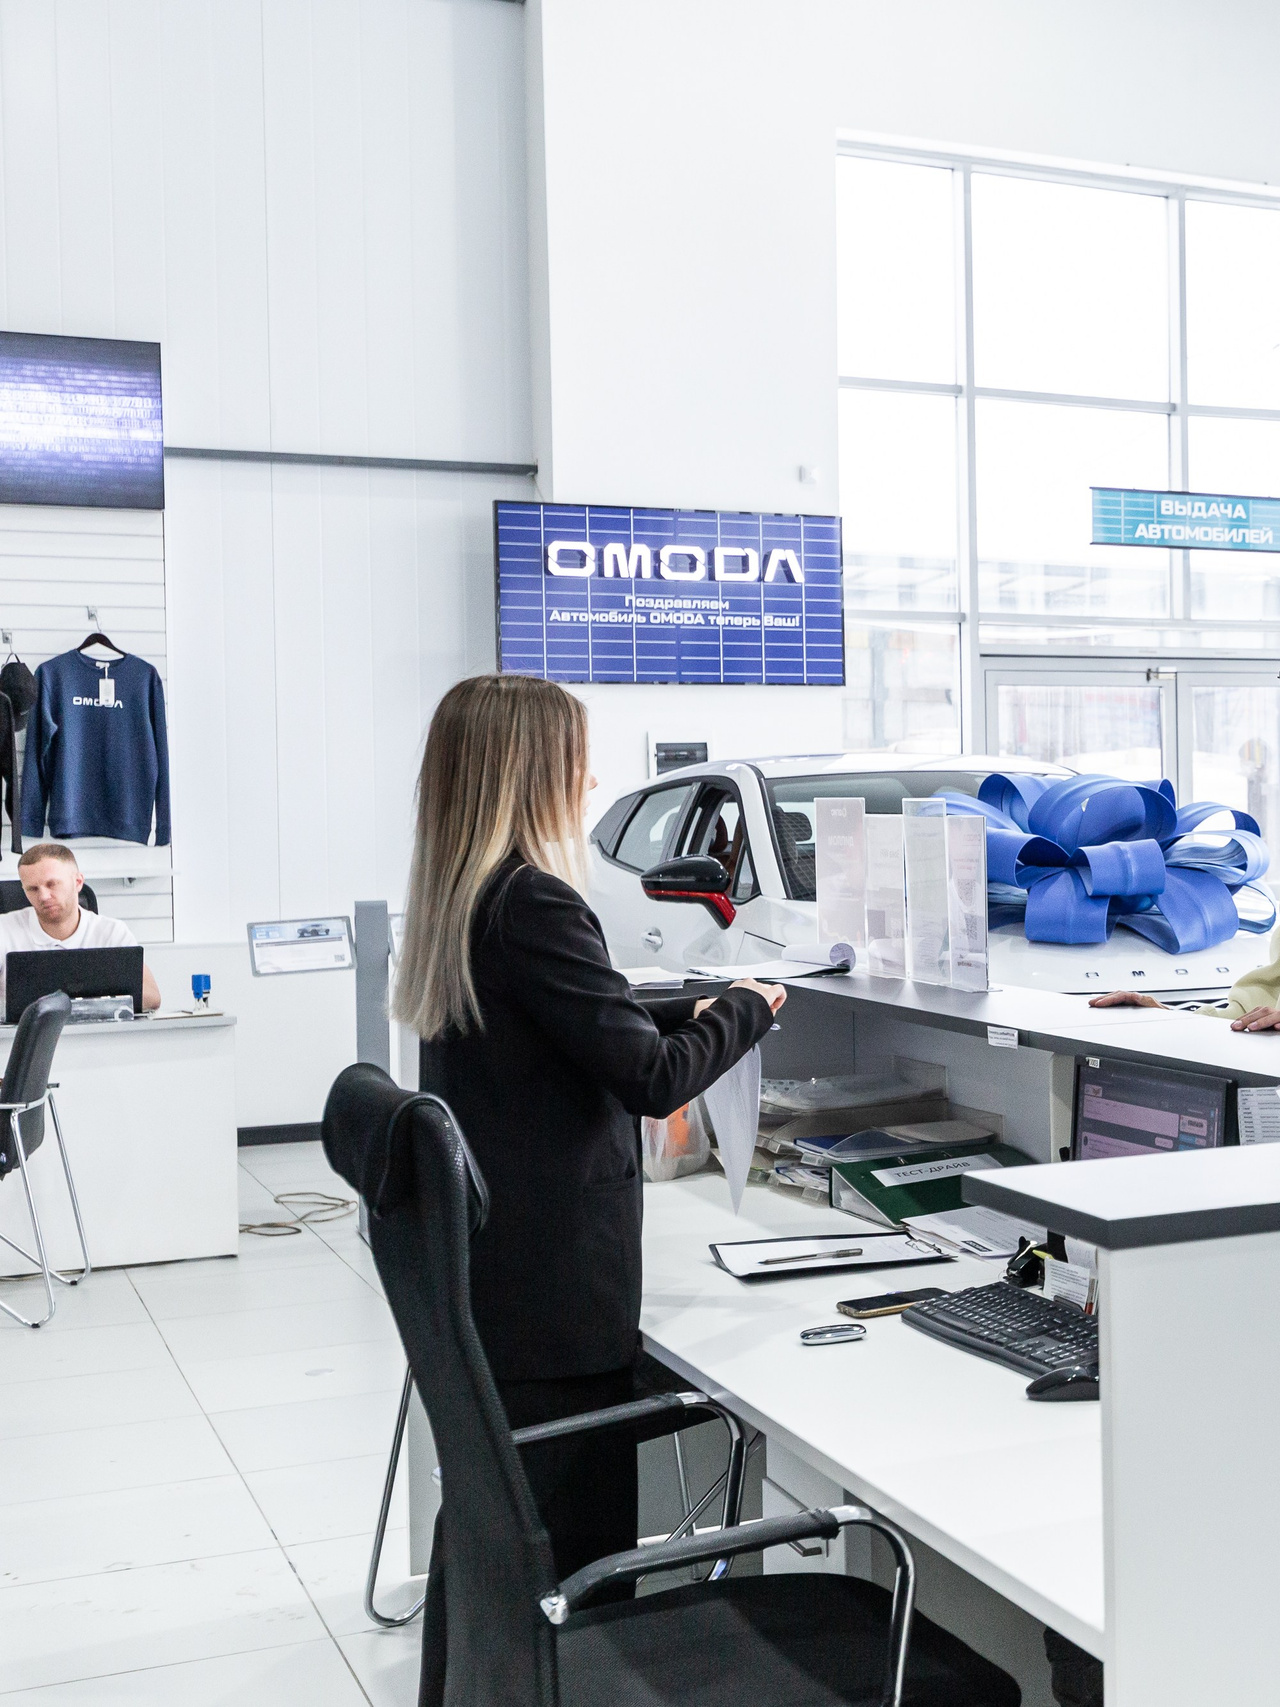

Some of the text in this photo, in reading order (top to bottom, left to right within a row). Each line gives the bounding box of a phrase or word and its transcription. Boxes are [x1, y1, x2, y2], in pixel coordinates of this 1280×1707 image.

[1160, 499, 1247, 519] ВЫДАЧА
[1134, 523, 1274, 544] АВТОМОБИЛЕЙ
[547, 540, 805, 583] OMODA
[624, 595, 729, 611] Поздравляем
[549, 609, 800, 628] Автомобиль OMODA теперь Ваш!
[72, 696, 123, 709] OMOA
[1085, 965, 1260, 979] OMOD
[894, 1161, 971, 1178] ТЕСТ-ДРАЙВ
